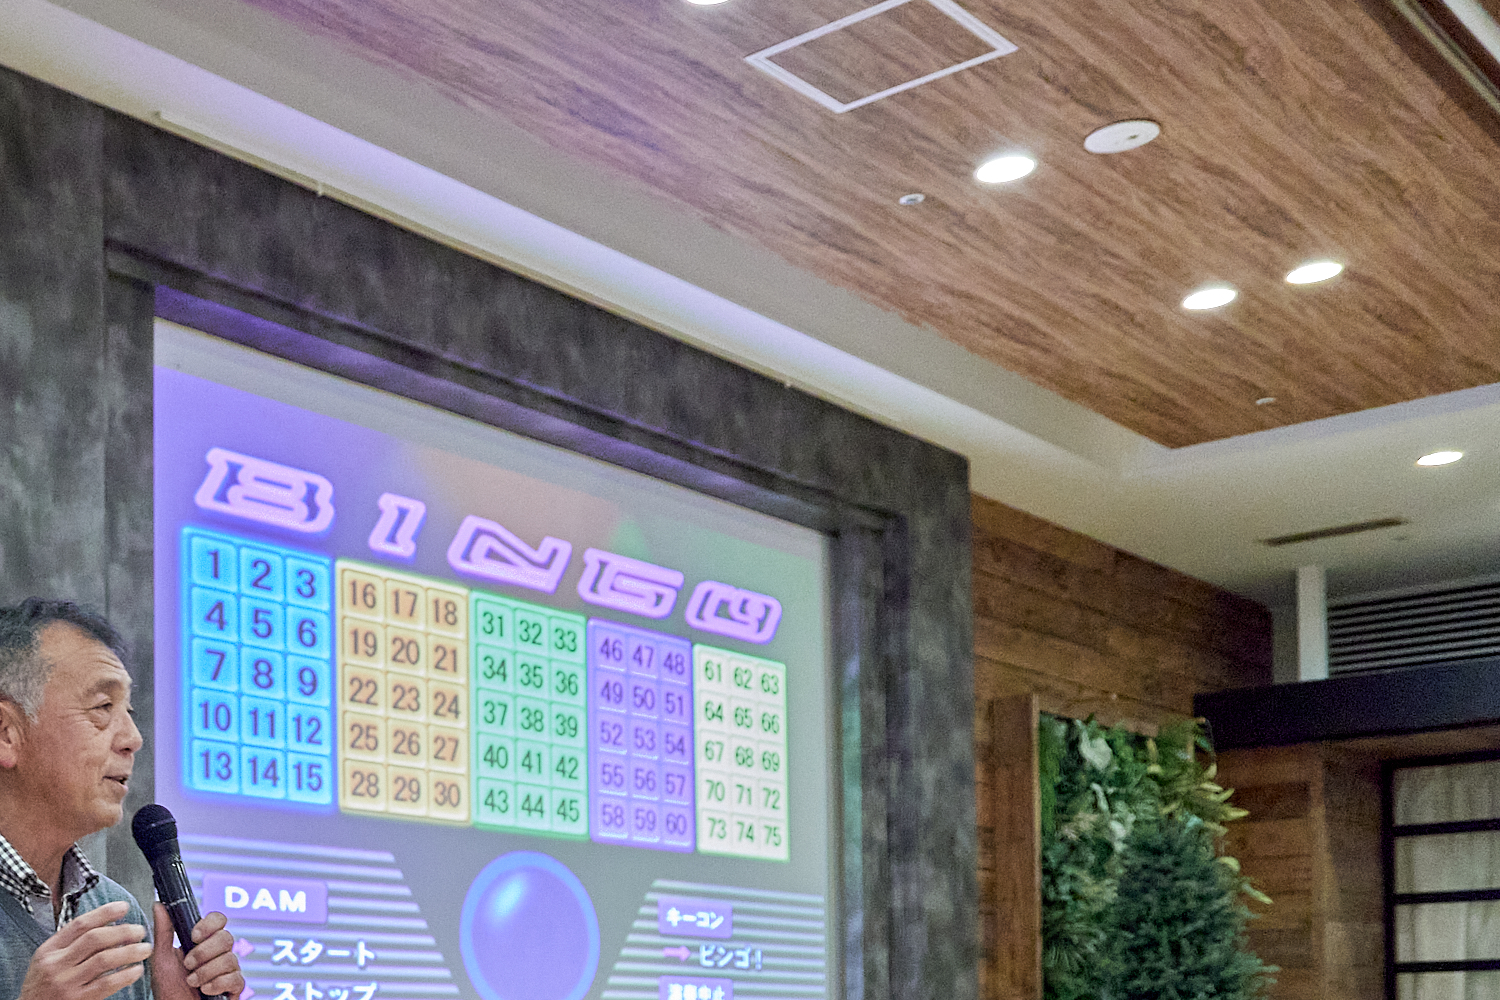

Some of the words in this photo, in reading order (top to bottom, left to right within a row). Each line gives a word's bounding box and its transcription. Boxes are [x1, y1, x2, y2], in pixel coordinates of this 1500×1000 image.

[207, 549, 220, 580] 1
[250, 558, 273, 592] 2
[295, 568, 317, 599] 3
[350, 580, 377, 610] 16
[393, 589, 418, 618] 17
[433, 598, 459, 627] 18
[204, 600, 228, 631] 4
[251, 607, 274, 639] 5
[296, 618, 318, 648] 6
[482, 610, 504, 638] 31
[519, 619, 543, 646] 32
[554, 627, 578, 654] 33
[351, 628, 378, 658] 19
[391, 636, 421, 666] 20
[433, 644, 458, 674] 21
[599, 637, 623, 662] 46
[632, 644, 655, 668] 47
[662, 652, 685, 676] 48
[205, 648, 227, 682] 7
[251, 658, 275, 690] 8
[297, 666, 319, 697] 9
[483, 655, 508, 682] 34
[519, 662, 544, 690] 35
[555, 669, 579, 697] 36
[703, 660, 722, 683] 61
[732, 666, 752, 691] 62
[759, 673, 779, 696] 63
[348, 676, 379, 707] 22
[391, 683, 421, 713] 23
[433, 690, 461, 720] 24
[600, 680, 624, 705] 49
[632, 685, 656, 711] 50
[664, 691, 684, 716] 51
[199, 700, 232, 732] 10
[249, 707, 276, 739] 11
[293, 714, 322, 745] 12
[483, 699, 509, 726] 37
[520, 706, 545, 733] 38
[555, 712, 579, 739] 39
[704, 700, 724, 722] 64
[733, 706, 753, 729] 65
[760, 712, 779, 735] 66
[349, 722, 379, 752] 25
[392, 728, 421, 757] 26
[433, 734, 460, 763] 27
[599, 720, 624, 747] 52
[633, 726, 657, 752] 53
[664, 732, 686, 756] 54
[703, 739, 725, 762] 67
[734, 746, 754, 769] 68
[760, 750, 780, 773] 69
[200, 749, 233, 781] 13
[248, 756, 280, 787] 14
[293, 761, 323, 792] 15
[482, 744, 509, 770] 40
[520, 749, 542, 774] 41
[555, 755, 579, 780] 42
[600, 762, 625, 789] 55
[633, 767, 657, 792] 56
[664, 772, 687, 797] 57
[350, 769, 380, 799] 28
[393, 775, 421, 804] 29
[433, 780, 462, 809] 30
[483, 788, 509, 814] 43
[520, 793, 545, 817] 44
[556, 798, 580, 823] 45
[705, 778, 726, 803] 70
[735, 783, 753, 806] 71
[760, 786, 780, 811] 72
[601, 803, 625, 829] 58
[634, 807, 657, 832] 59
[664, 812, 688, 836] 60
[707, 816, 727, 841] 73
[737, 821, 755, 842] 74
[763, 824, 782, 848] 75
[224, 885, 307, 913] DAM
[665, 906, 725, 930] キーコン
[272, 938, 376, 967] スタート
